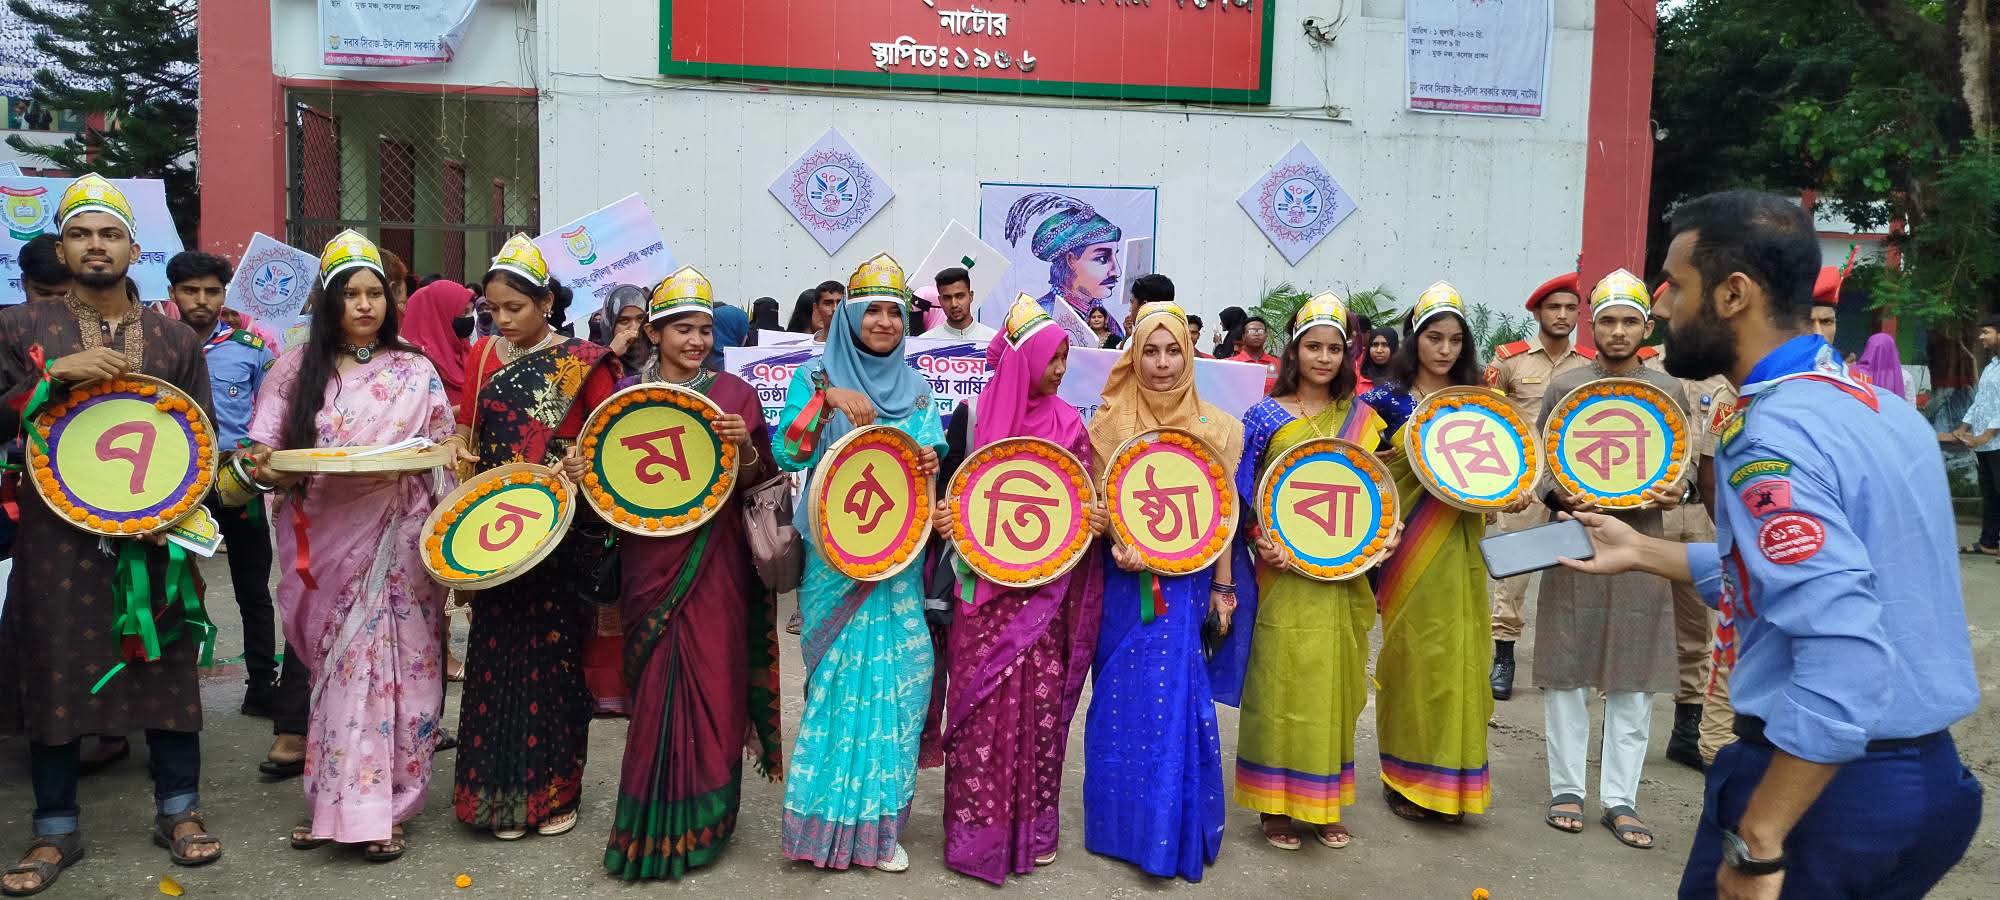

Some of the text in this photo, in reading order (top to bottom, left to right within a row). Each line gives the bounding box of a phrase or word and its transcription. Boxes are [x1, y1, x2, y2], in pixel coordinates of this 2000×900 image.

[938, 6, 1009, 36] নাটোর
[918, 355, 987, 376] ৭০তম
[95, 420, 157, 494] ৭
[620, 425, 690, 485] ম
[1434, 418, 1512, 489] র্ষি
[1573, 407, 1651, 480] কী
[478, 501, 542, 551] ত
[844, 463, 896, 534] প্র
[983, 469, 1059, 551] তি
[1133, 464, 1200, 542] ষ্ঠা
[1289, 480, 1361, 538] বা
